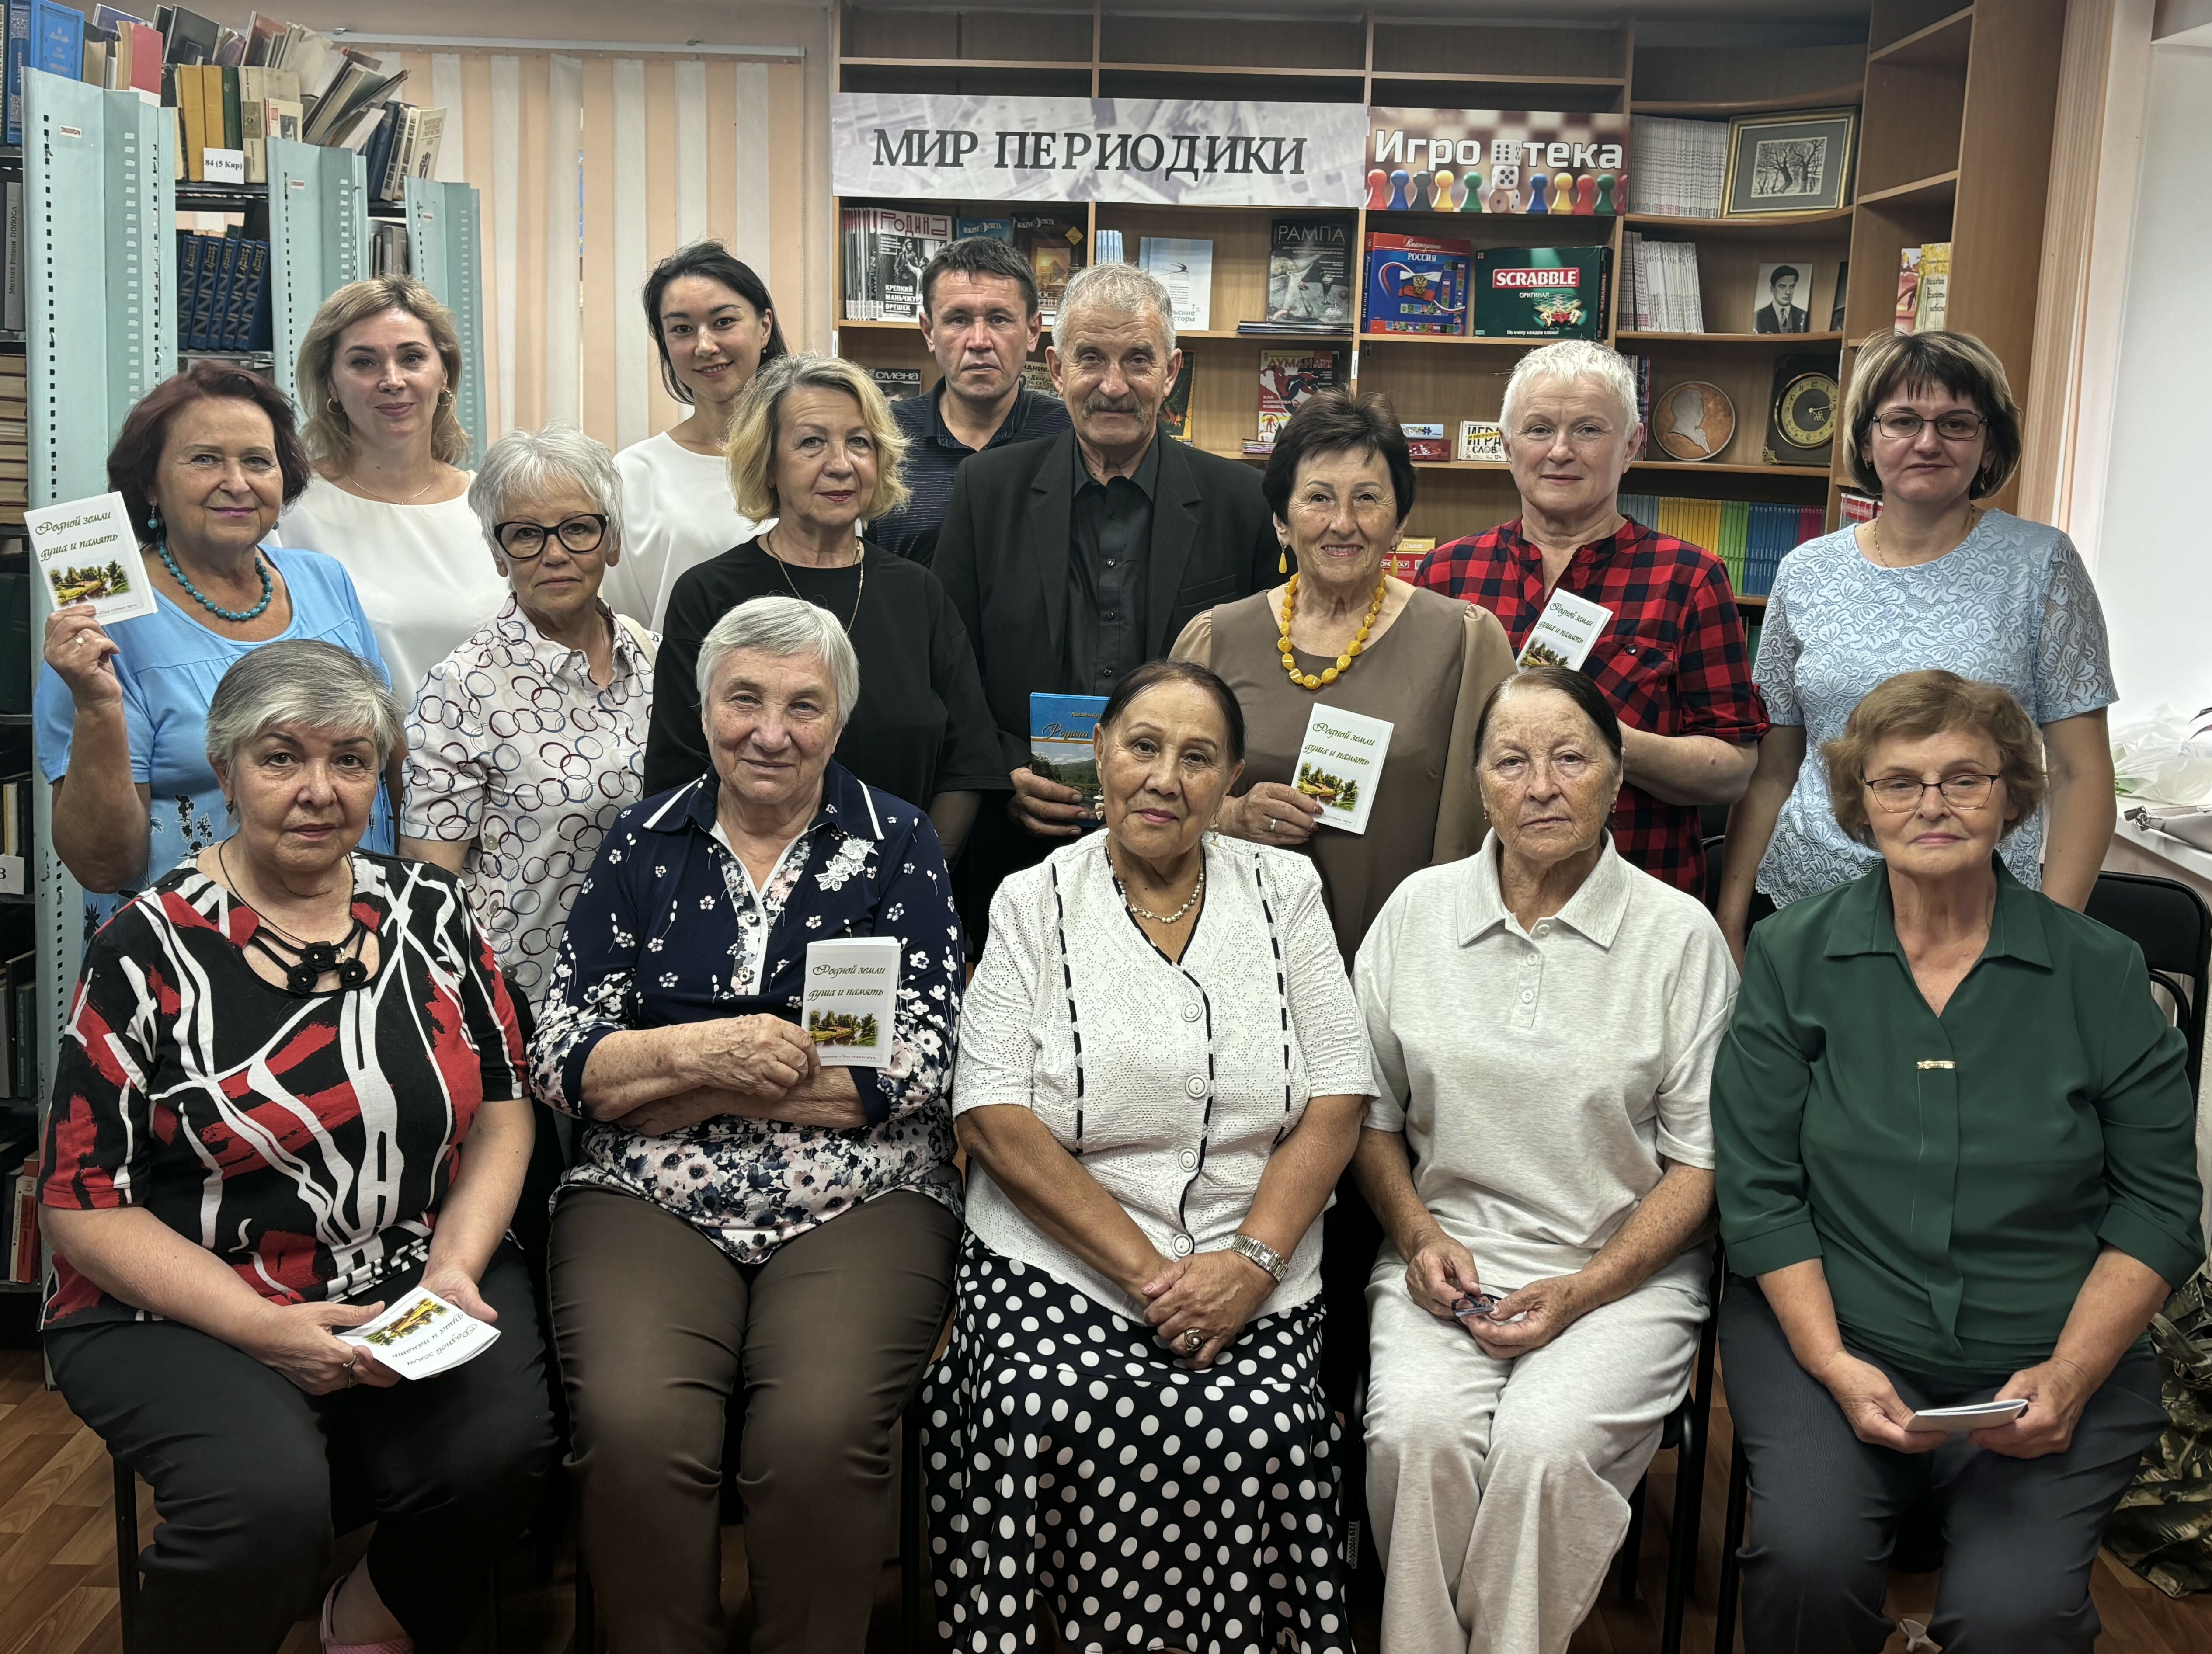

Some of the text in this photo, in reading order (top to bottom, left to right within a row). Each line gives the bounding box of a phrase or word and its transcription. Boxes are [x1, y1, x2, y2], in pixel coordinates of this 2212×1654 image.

[873, 129, 1308, 181] МИР ПЕРИОДИКИ
[1374, 129, 1623, 172] Игро тека
[216, 160, 223, 169] (5
[224, 162, 243, 170] Кир)
[1278, 226, 1346, 242] РАМПА
[1407, 253, 1436, 262] РОССИЯ
[1496, 271, 1576, 286] SCRABBLE
[885, 294, 923, 302] МАНЬЧЖУР
[35, 512, 111, 535] Родной земли
[40, 545, 68, 562] душа
[79, 534, 118, 549] память
[1549, 603, 1594, 626] Родной земли
[1536, 621, 1555, 632] душа
[1560, 629, 1584, 644] память
[1042, 723, 1089, 740] Родина
[1312, 723, 1375, 746] Родной земли
[1302, 744, 1329, 754] душа
[1336, 752, 1370, 765] память
[812, 964, 858, 978] Родной
[807, 990, 836, 1001] душа
[440, 1312, 464, 1334] душа
[392, 1338, 430, 1358] память
[407, 1324, 478, 1366] Родной земли
